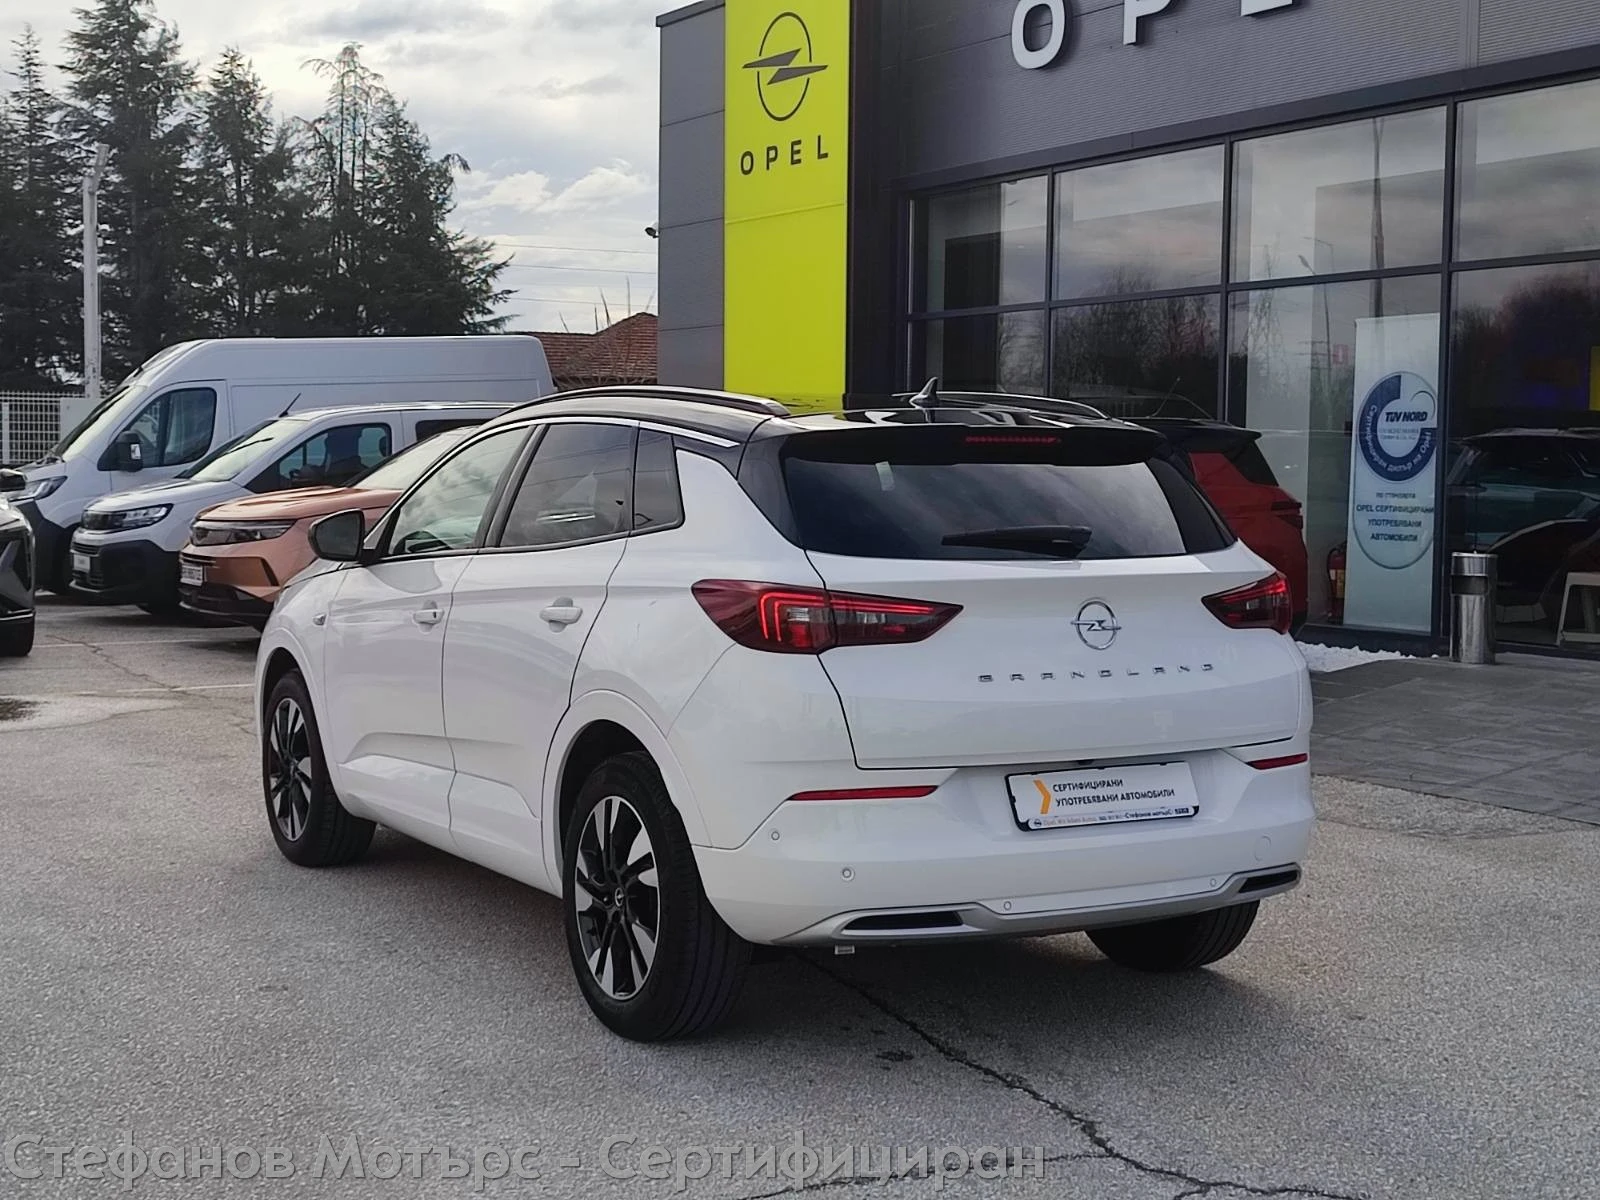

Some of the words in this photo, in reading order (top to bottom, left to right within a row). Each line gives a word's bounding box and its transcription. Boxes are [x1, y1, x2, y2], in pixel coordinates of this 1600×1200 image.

[1011, 0, 1293, 70] OP
[740, 134, 829, 176] OPEL
[1402, 411, 1428, 422] NORD
[1356, 504, 1375, 512] OPEL
[977, 663, 1214, 683] GRANDLAND
[1052, 778, 1124, 793] СЕРТИФИЦИРАНИ
[1055, 794, 1119, 808] УПОТРЕБЯВАНИ
[1120, 788, 1175, 802] АВТОМОБИЛИ
